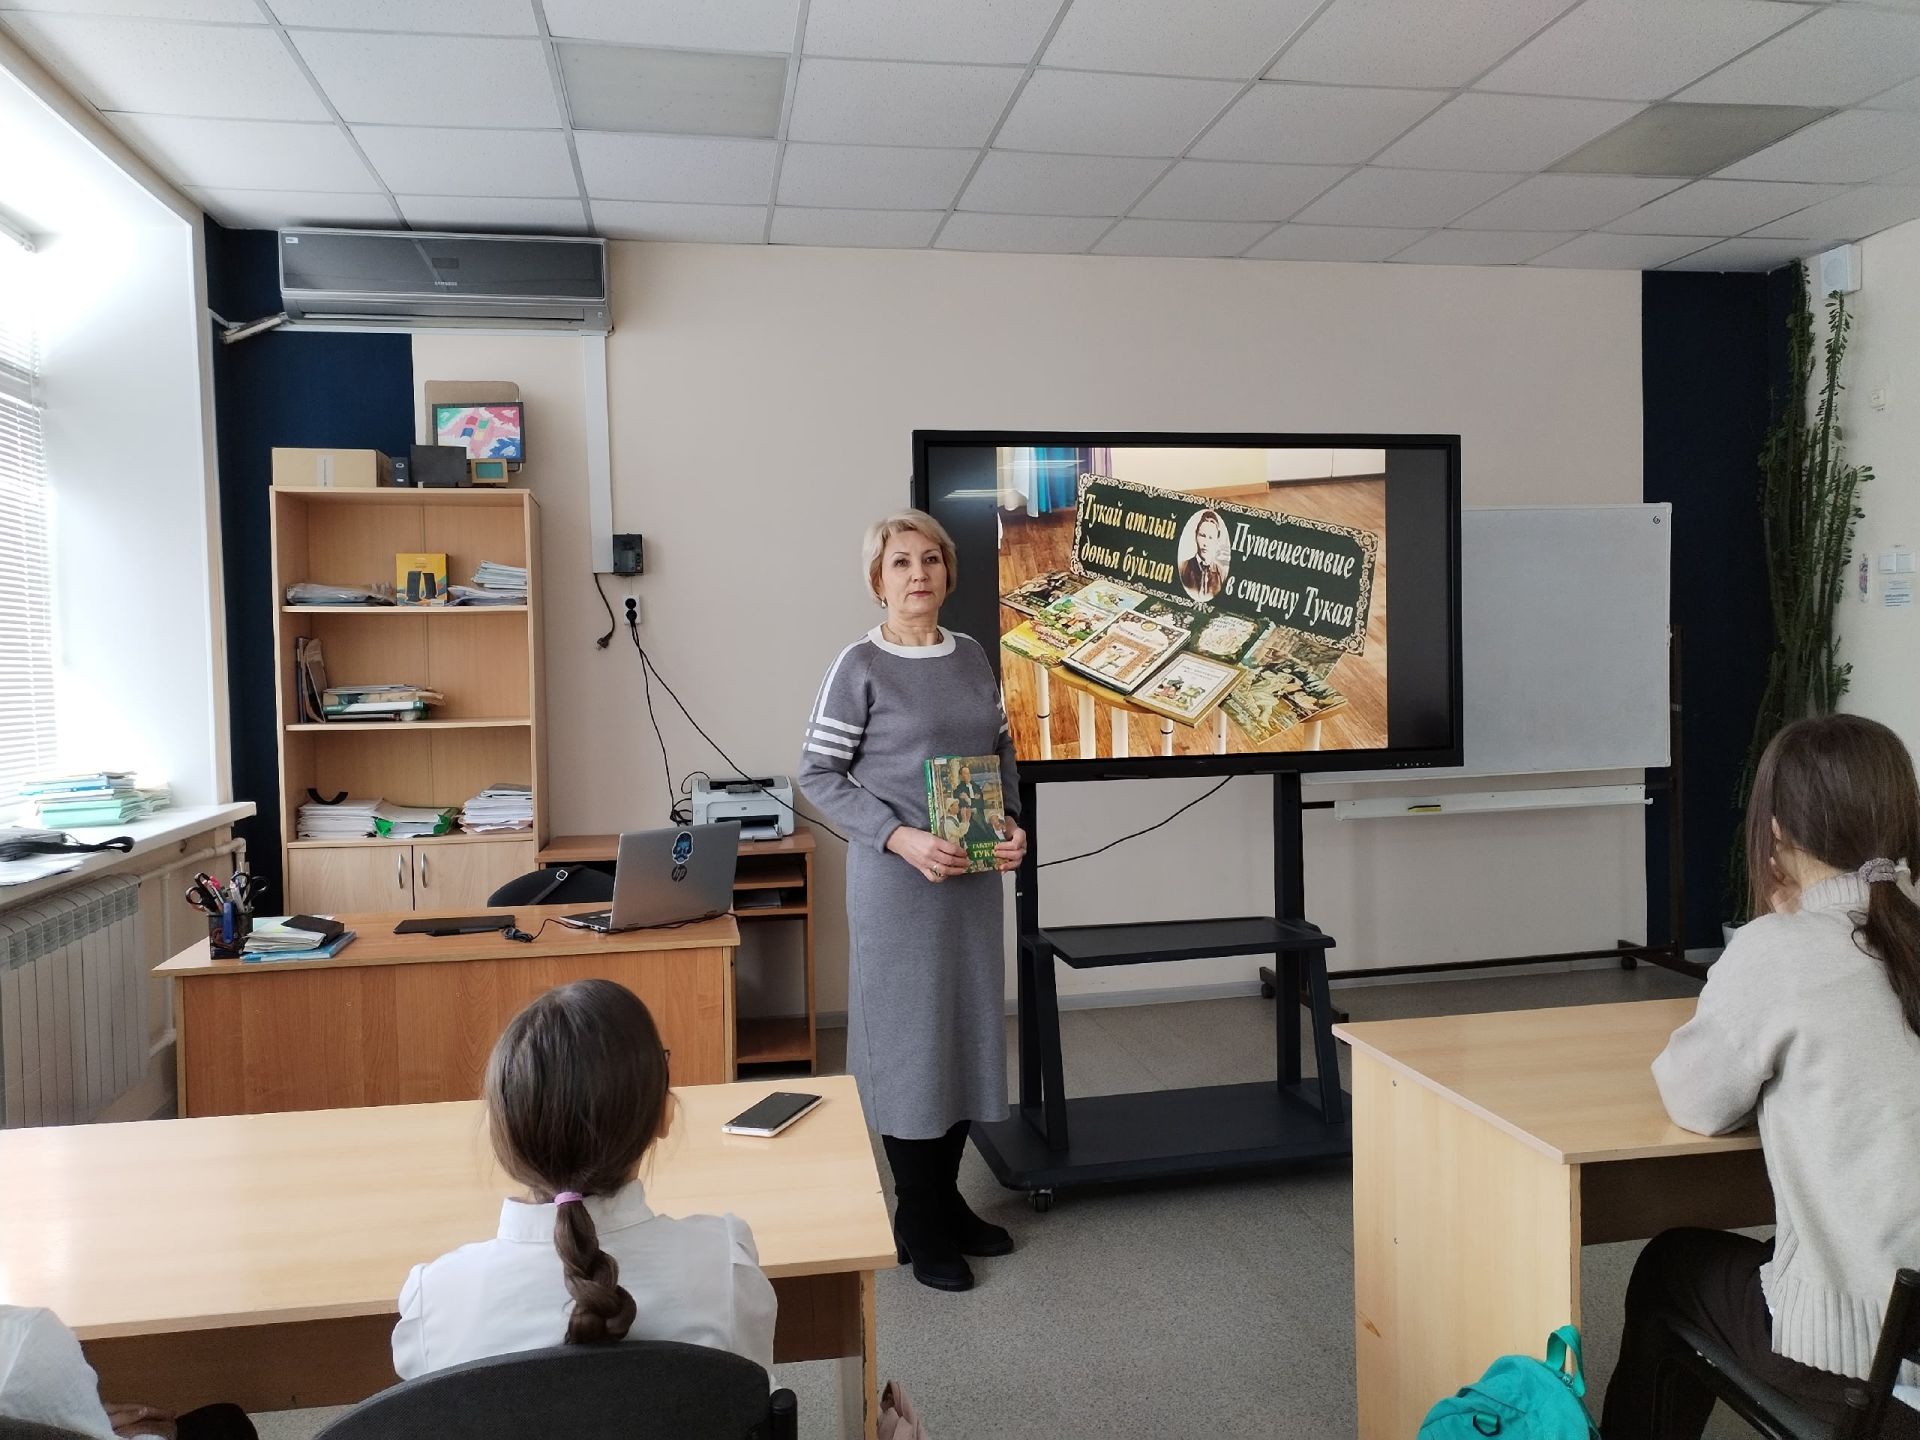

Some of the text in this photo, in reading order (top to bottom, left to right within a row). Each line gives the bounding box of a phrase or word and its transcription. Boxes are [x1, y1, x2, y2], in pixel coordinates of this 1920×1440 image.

[1084, 493, 1177, 540] Тукай атлый
[1081, 535, 1174, 584] дөнья буйлап
[1231, 522, 1355, 579] Путешествие
[1225, 576, 1354, 627] в страну Тукая
